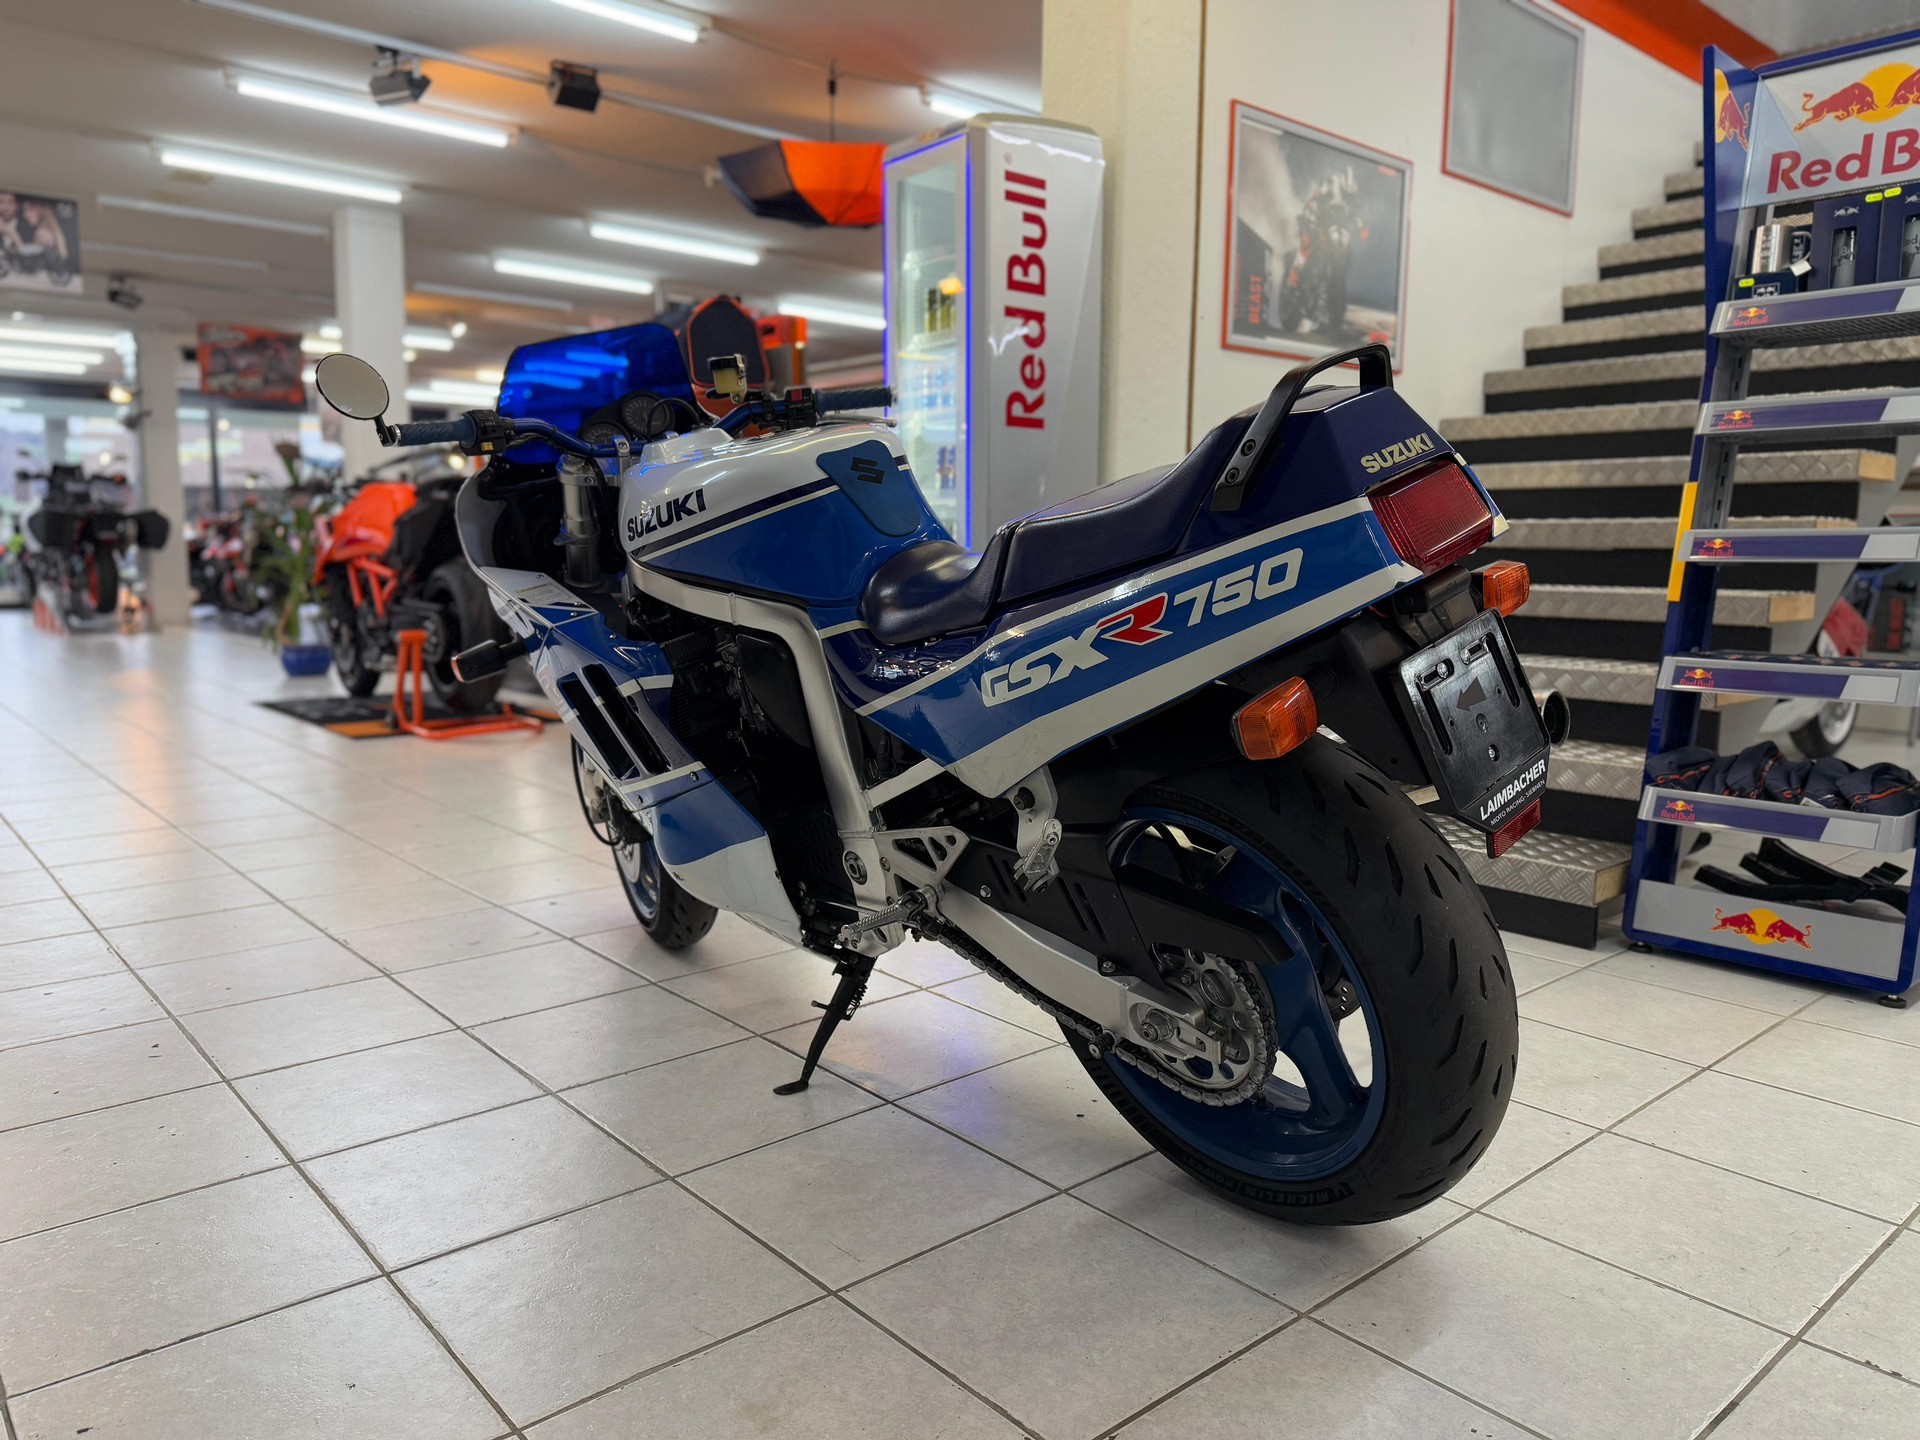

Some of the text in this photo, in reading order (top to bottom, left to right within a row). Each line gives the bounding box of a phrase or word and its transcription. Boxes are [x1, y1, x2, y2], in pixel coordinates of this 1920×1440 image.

[1767, 128, 1920, 194] Red B
[1004, 169, 1047, 430] Red Bull
[1361, 432, 1435, 473] SUZUKI
[627, 488, 706, 541] SUZUKI
[1173, 548, 1303, 627] 750
[1480, 759, 1546, 821] LAIMBACHER
[1490, 810, 1507, 826] MOTO
[1661, 809, 1696, 821] Red Bull
